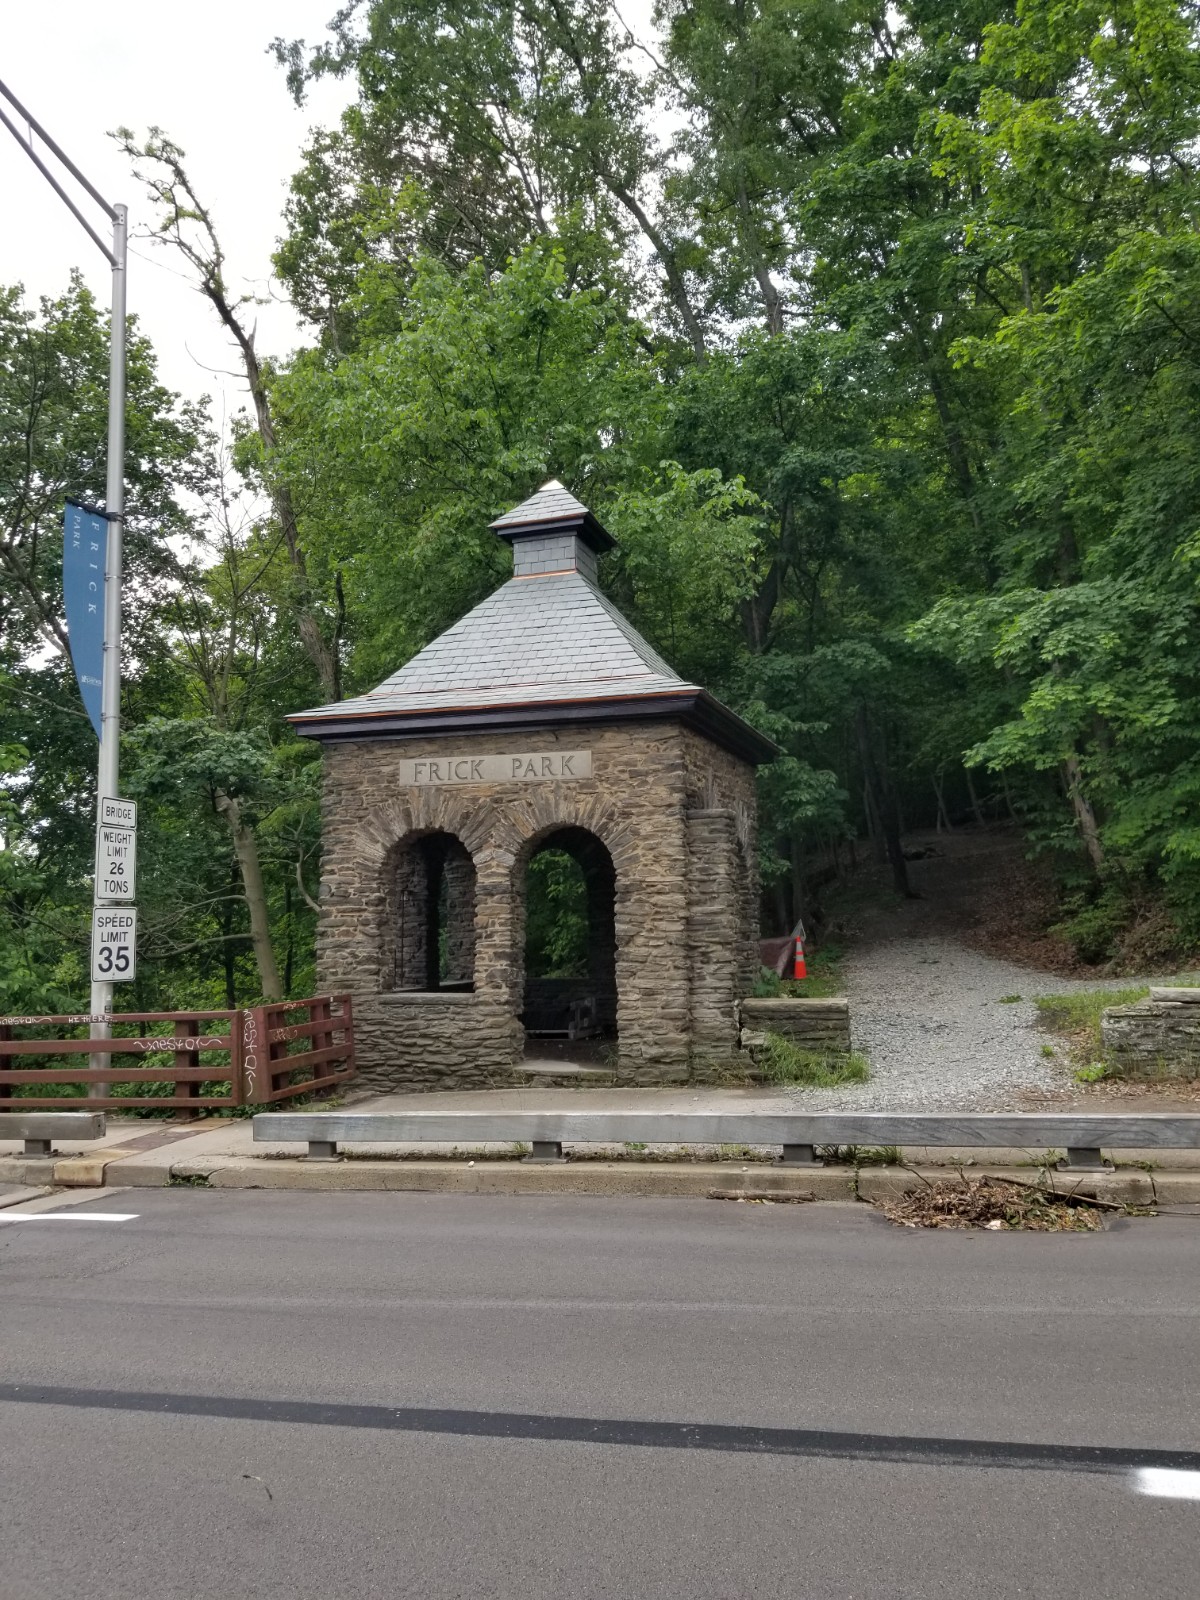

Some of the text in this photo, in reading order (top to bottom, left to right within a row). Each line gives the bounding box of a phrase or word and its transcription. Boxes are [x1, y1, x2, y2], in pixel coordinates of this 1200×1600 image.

[72, 515, 81, 550] PARK
[88, 521, 100, 615] FRICK
[413, 755, 576, 783] FRICK PARK
[105, 806, 132, 820] BRIDGE
[103, 831, 132, 845] WEIGHT
[107, 845, 128, 858] LIMIT
[109, 861, 125, 876] 26
[103, 879, 129, 894] TONS
[97, 916, 133, 928] SPEED
[100, 931, 129, 943] LIMIT
[97, 945, 130, 973] 35
